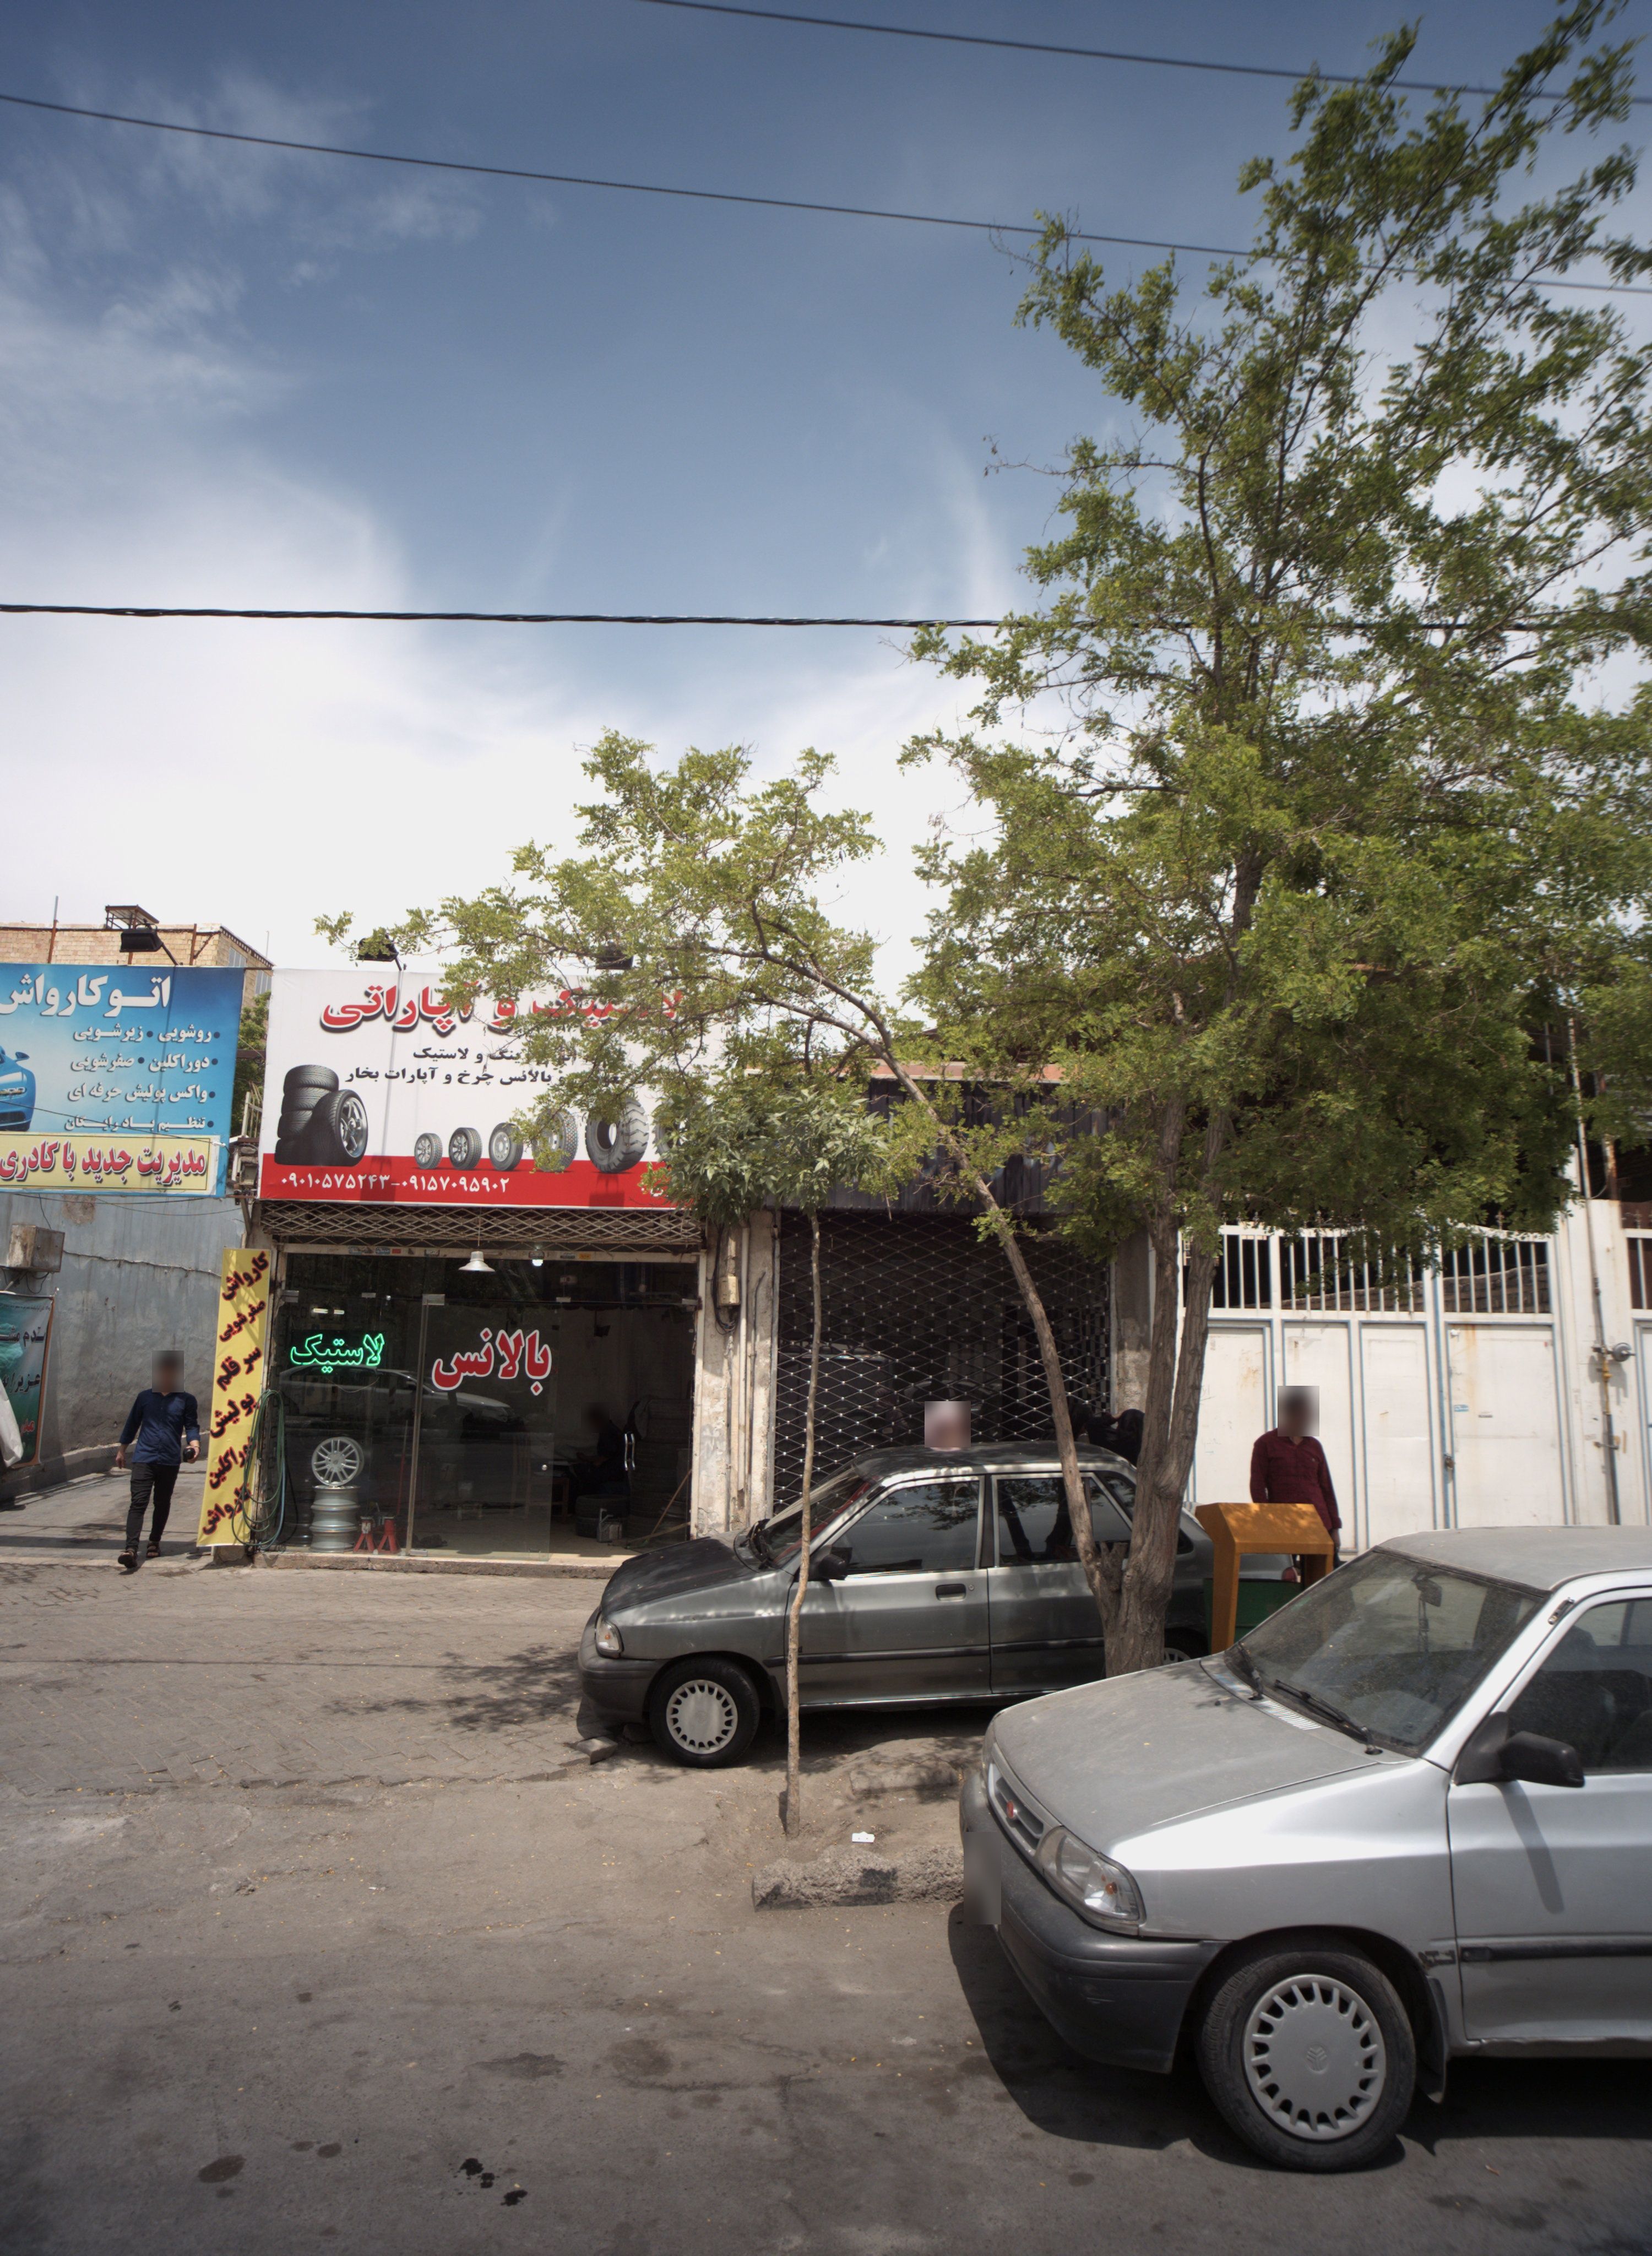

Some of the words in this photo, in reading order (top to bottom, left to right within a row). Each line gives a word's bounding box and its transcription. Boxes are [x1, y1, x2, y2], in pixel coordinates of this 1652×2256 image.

[73, 1022, 144, 1042] زیرشویی
[158, 1024, 212, 1043] روشویی
[149, 1053, 210, 1073] دوراکلین
[413, 1047, 469, 1062] لاستیک
[474, 1053, 483, 1064] و
[345, 1066, 379, 1082] بخار
[384, 1066, 438, 1084] آپارات
[442, 1073, 452, 1084] و
[457, 1069, 494, 1086] چرخ
[499, 1069, 552, 1086] بالانس
[126, 1083, 166, 1104] پولیش
[169, 1084, 208, 1103] واکس
[64, 1115, 119, 1132] رایگان
[122, 1115, 155, 1131] باد
[157, 1116, 206, 1132] تنظیم
[61, 1139, 76, 1181] با
[81, 1145, 133, 1183] جدید
[137, 1146, 207, 1184] مدیریت
[222, 1250, 269, 1301] کارواش
[290, 1332, 385, 1374] لاستیک
[432, 1327, 552, 1396] بالانس
[202, 1482, 252, 1536] کارواش
